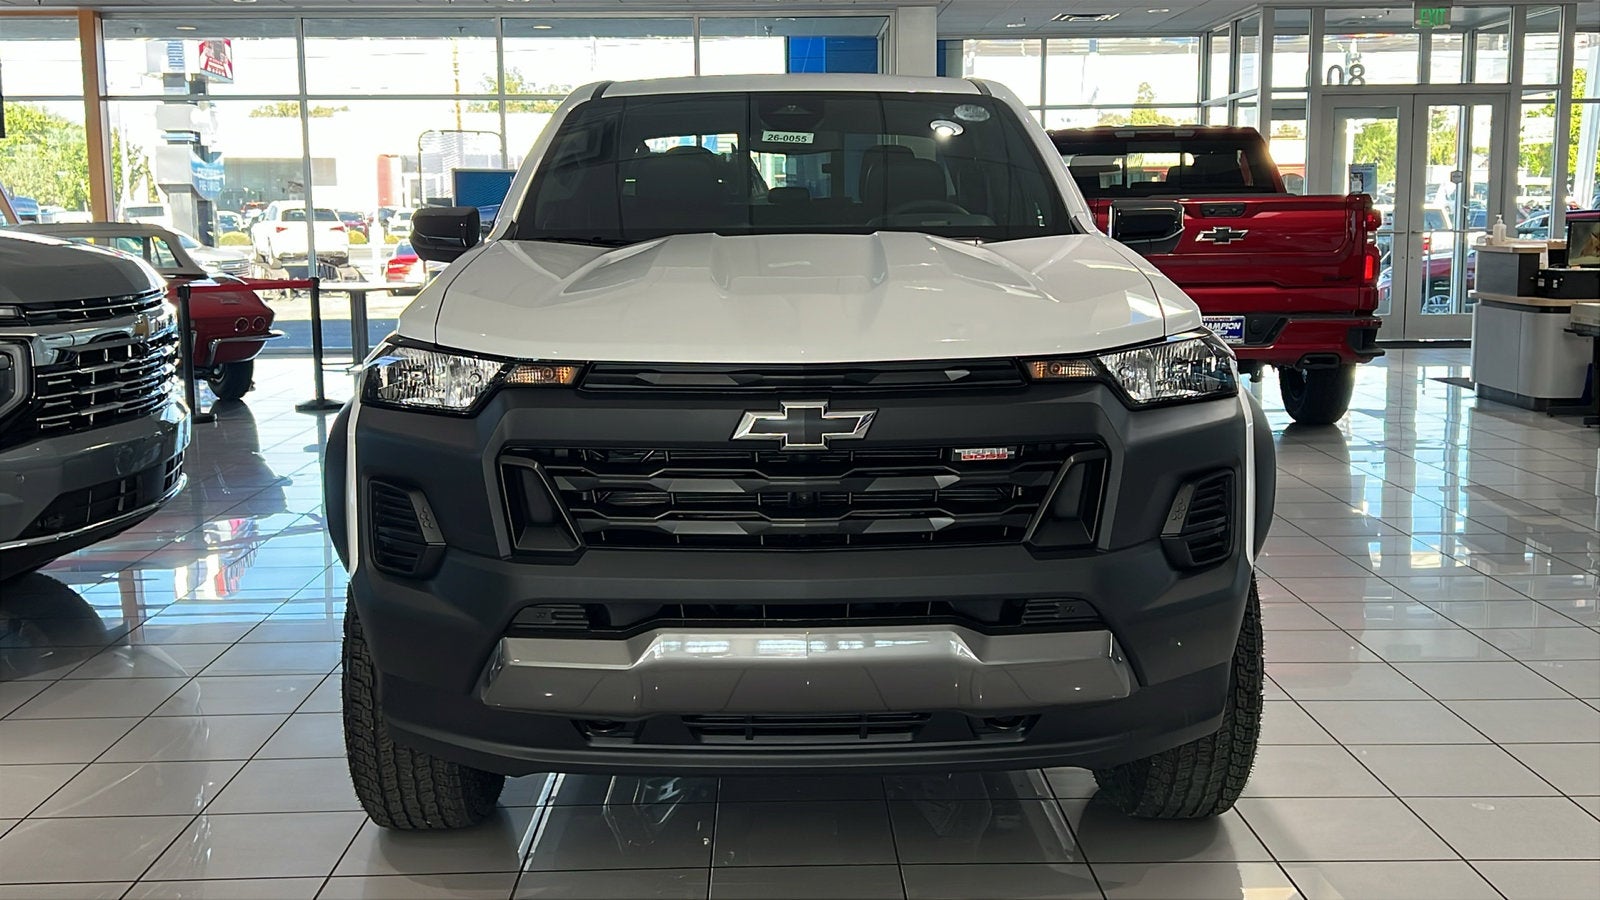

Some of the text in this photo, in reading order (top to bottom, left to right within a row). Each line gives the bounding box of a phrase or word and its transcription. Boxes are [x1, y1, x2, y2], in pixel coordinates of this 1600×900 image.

[1420, 7, 1446, 26] EXIT
[767, 133, 807, 143] 26-0055
[1203, 322, 1241, 330] HAMPION
[954, 447, 1015, 455] TRAIL
[961, 453, 1008, 461] BOSS
